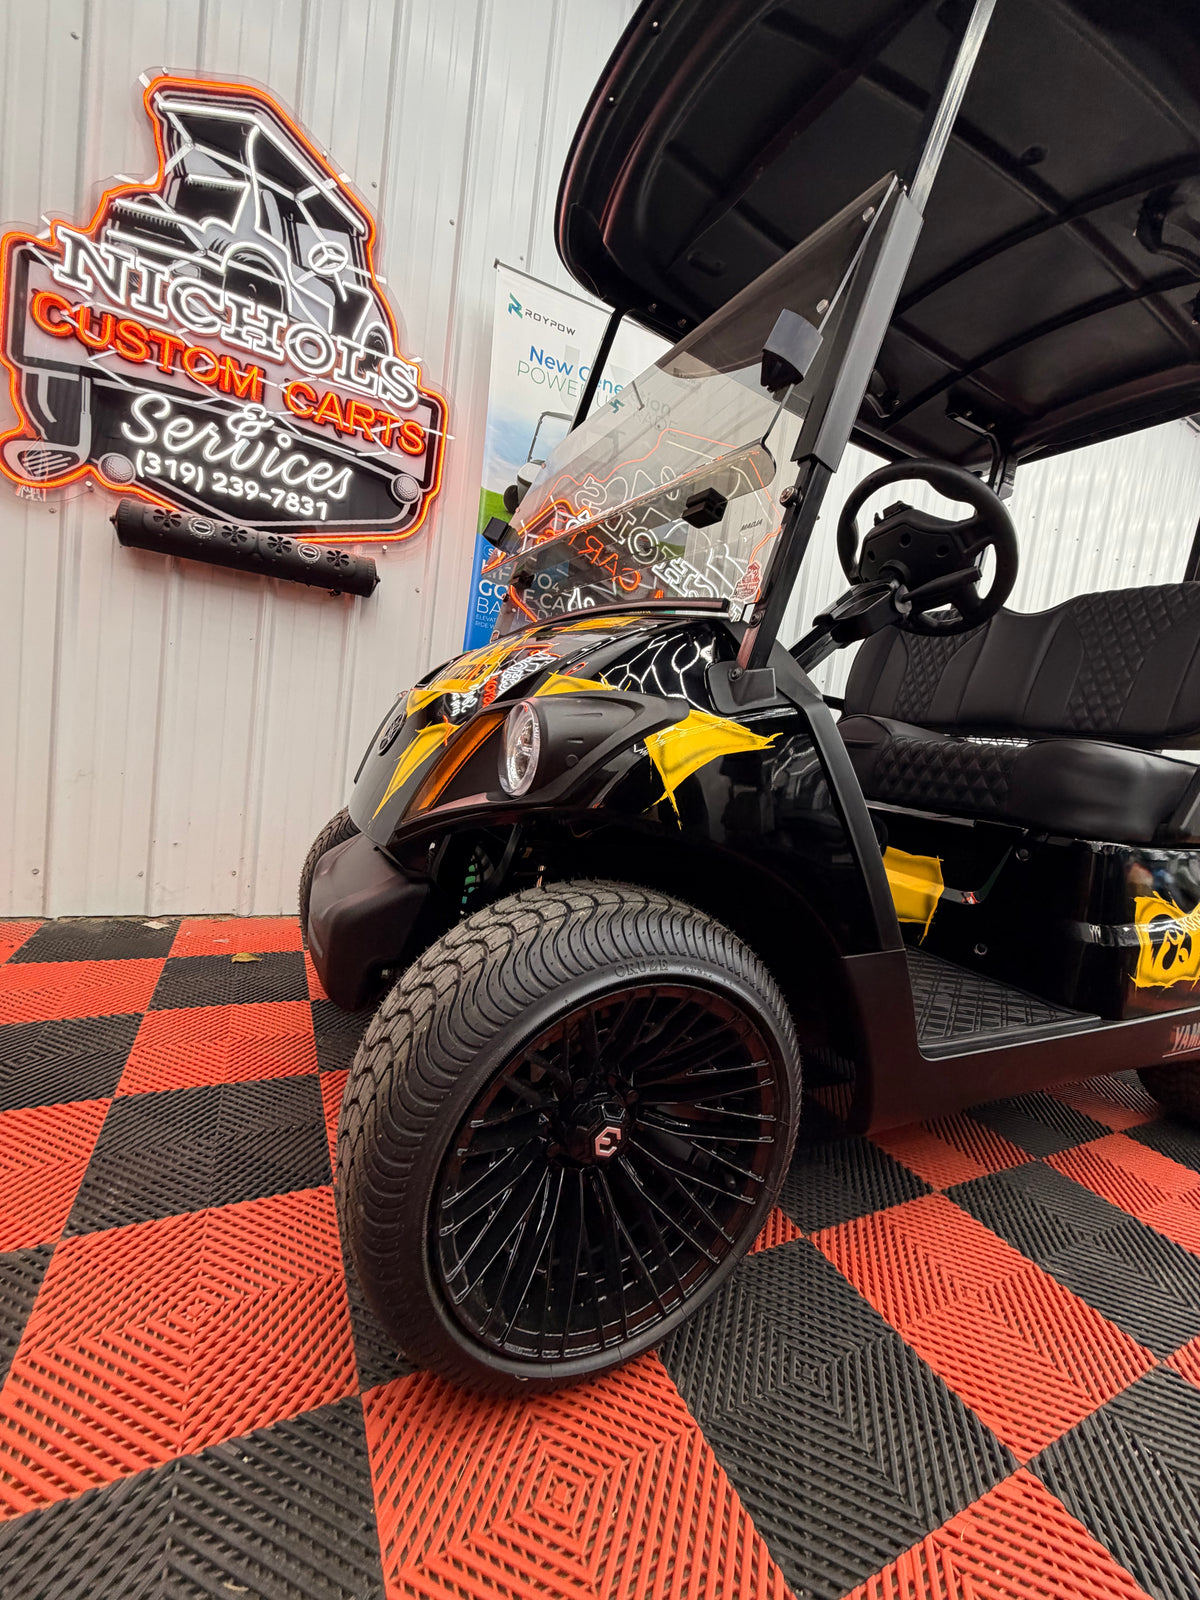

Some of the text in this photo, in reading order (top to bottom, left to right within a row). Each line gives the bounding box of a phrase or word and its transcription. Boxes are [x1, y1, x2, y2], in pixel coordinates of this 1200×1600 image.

[54, 227, 420, 408] NICHOLS
[524, 308, 576, 336] ROYPOW
[31, 289, 427, 457] CUSTOM CARTS
[528, 344, 574, 376] New
[516, 360, 586, 402] POWE
[227, 402, 274, 437] &
[121, 392, 353, 500] Services
[135, 449, 329, 520] (319) 239-7831
[614, 957, 669, 979] CRUZE
[1171, 1022, 1200, 1052] YAM
